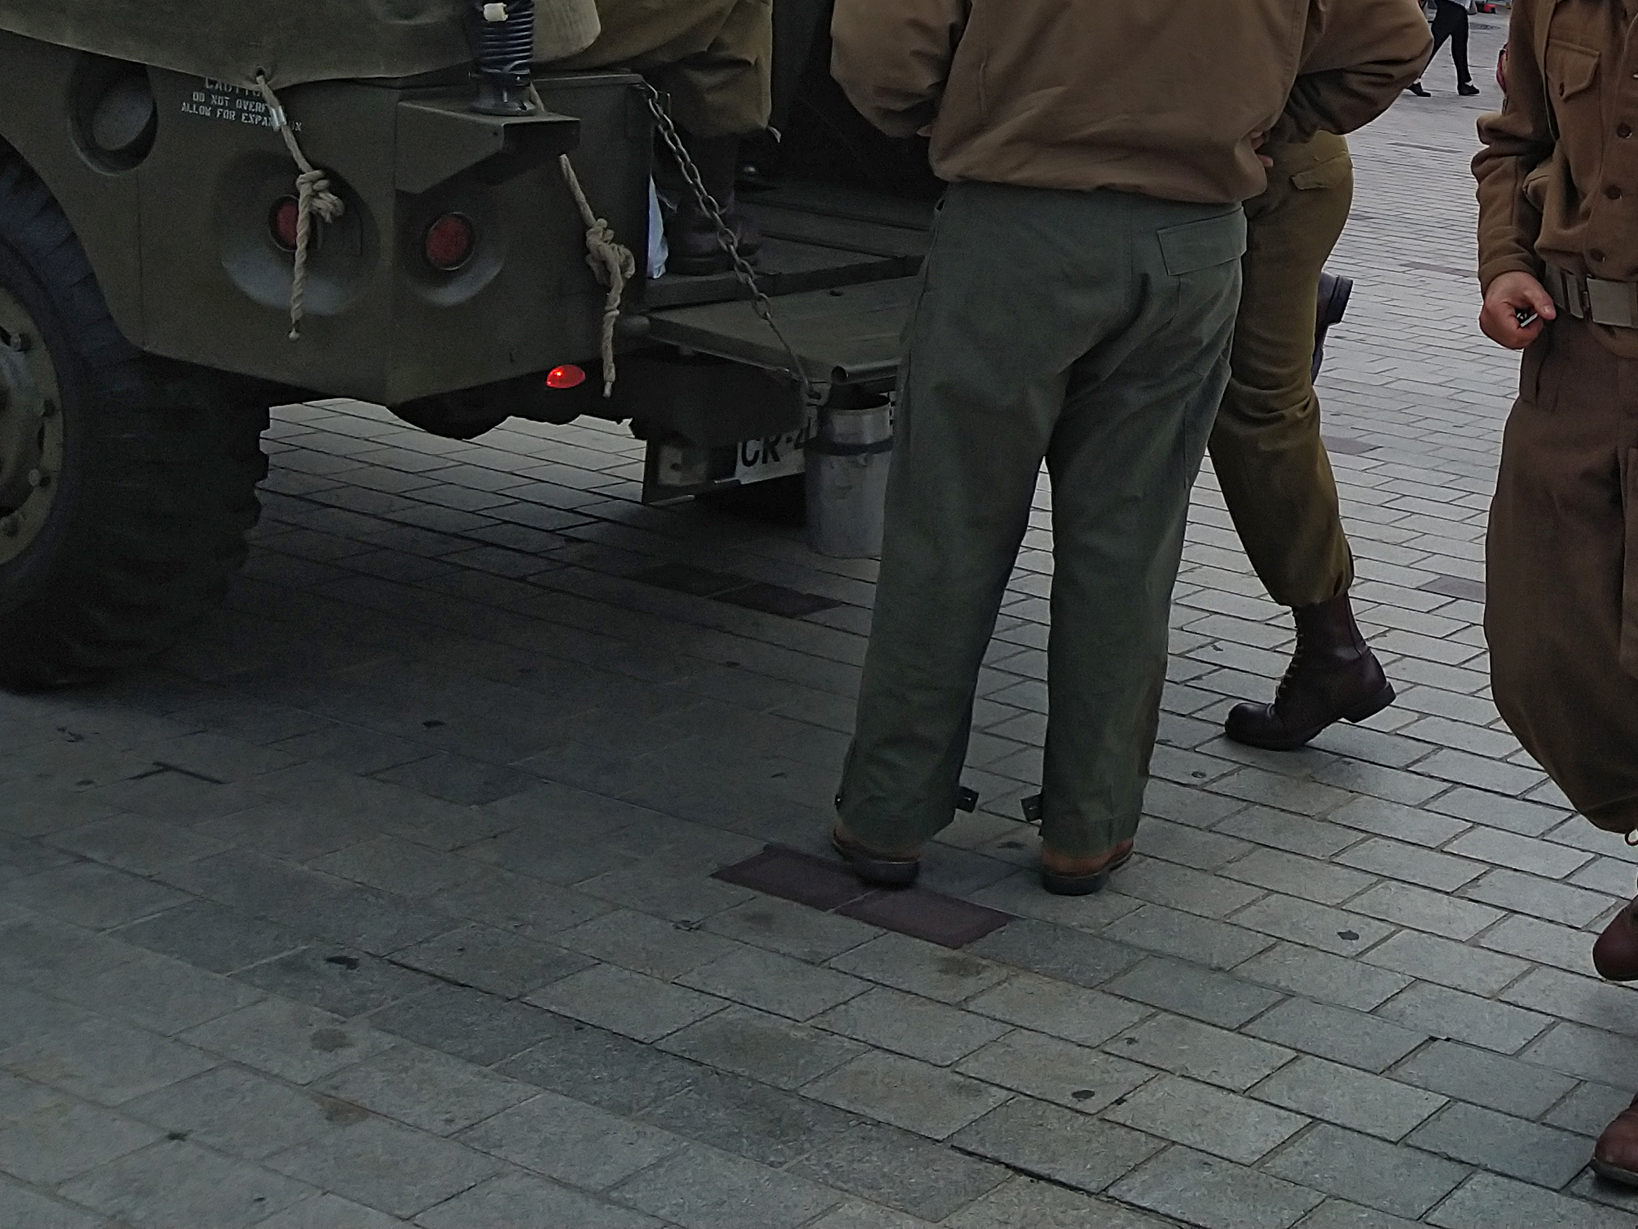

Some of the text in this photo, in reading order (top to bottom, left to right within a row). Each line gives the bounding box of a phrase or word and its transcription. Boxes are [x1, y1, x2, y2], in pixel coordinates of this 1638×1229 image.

[205, 77, 263, 98] CAUTIO
[181, 102, 212, 117] ALLOW
[217, 109, 236, 121] FOR
[192, 91, 267, 113] DO NOT OVERF
